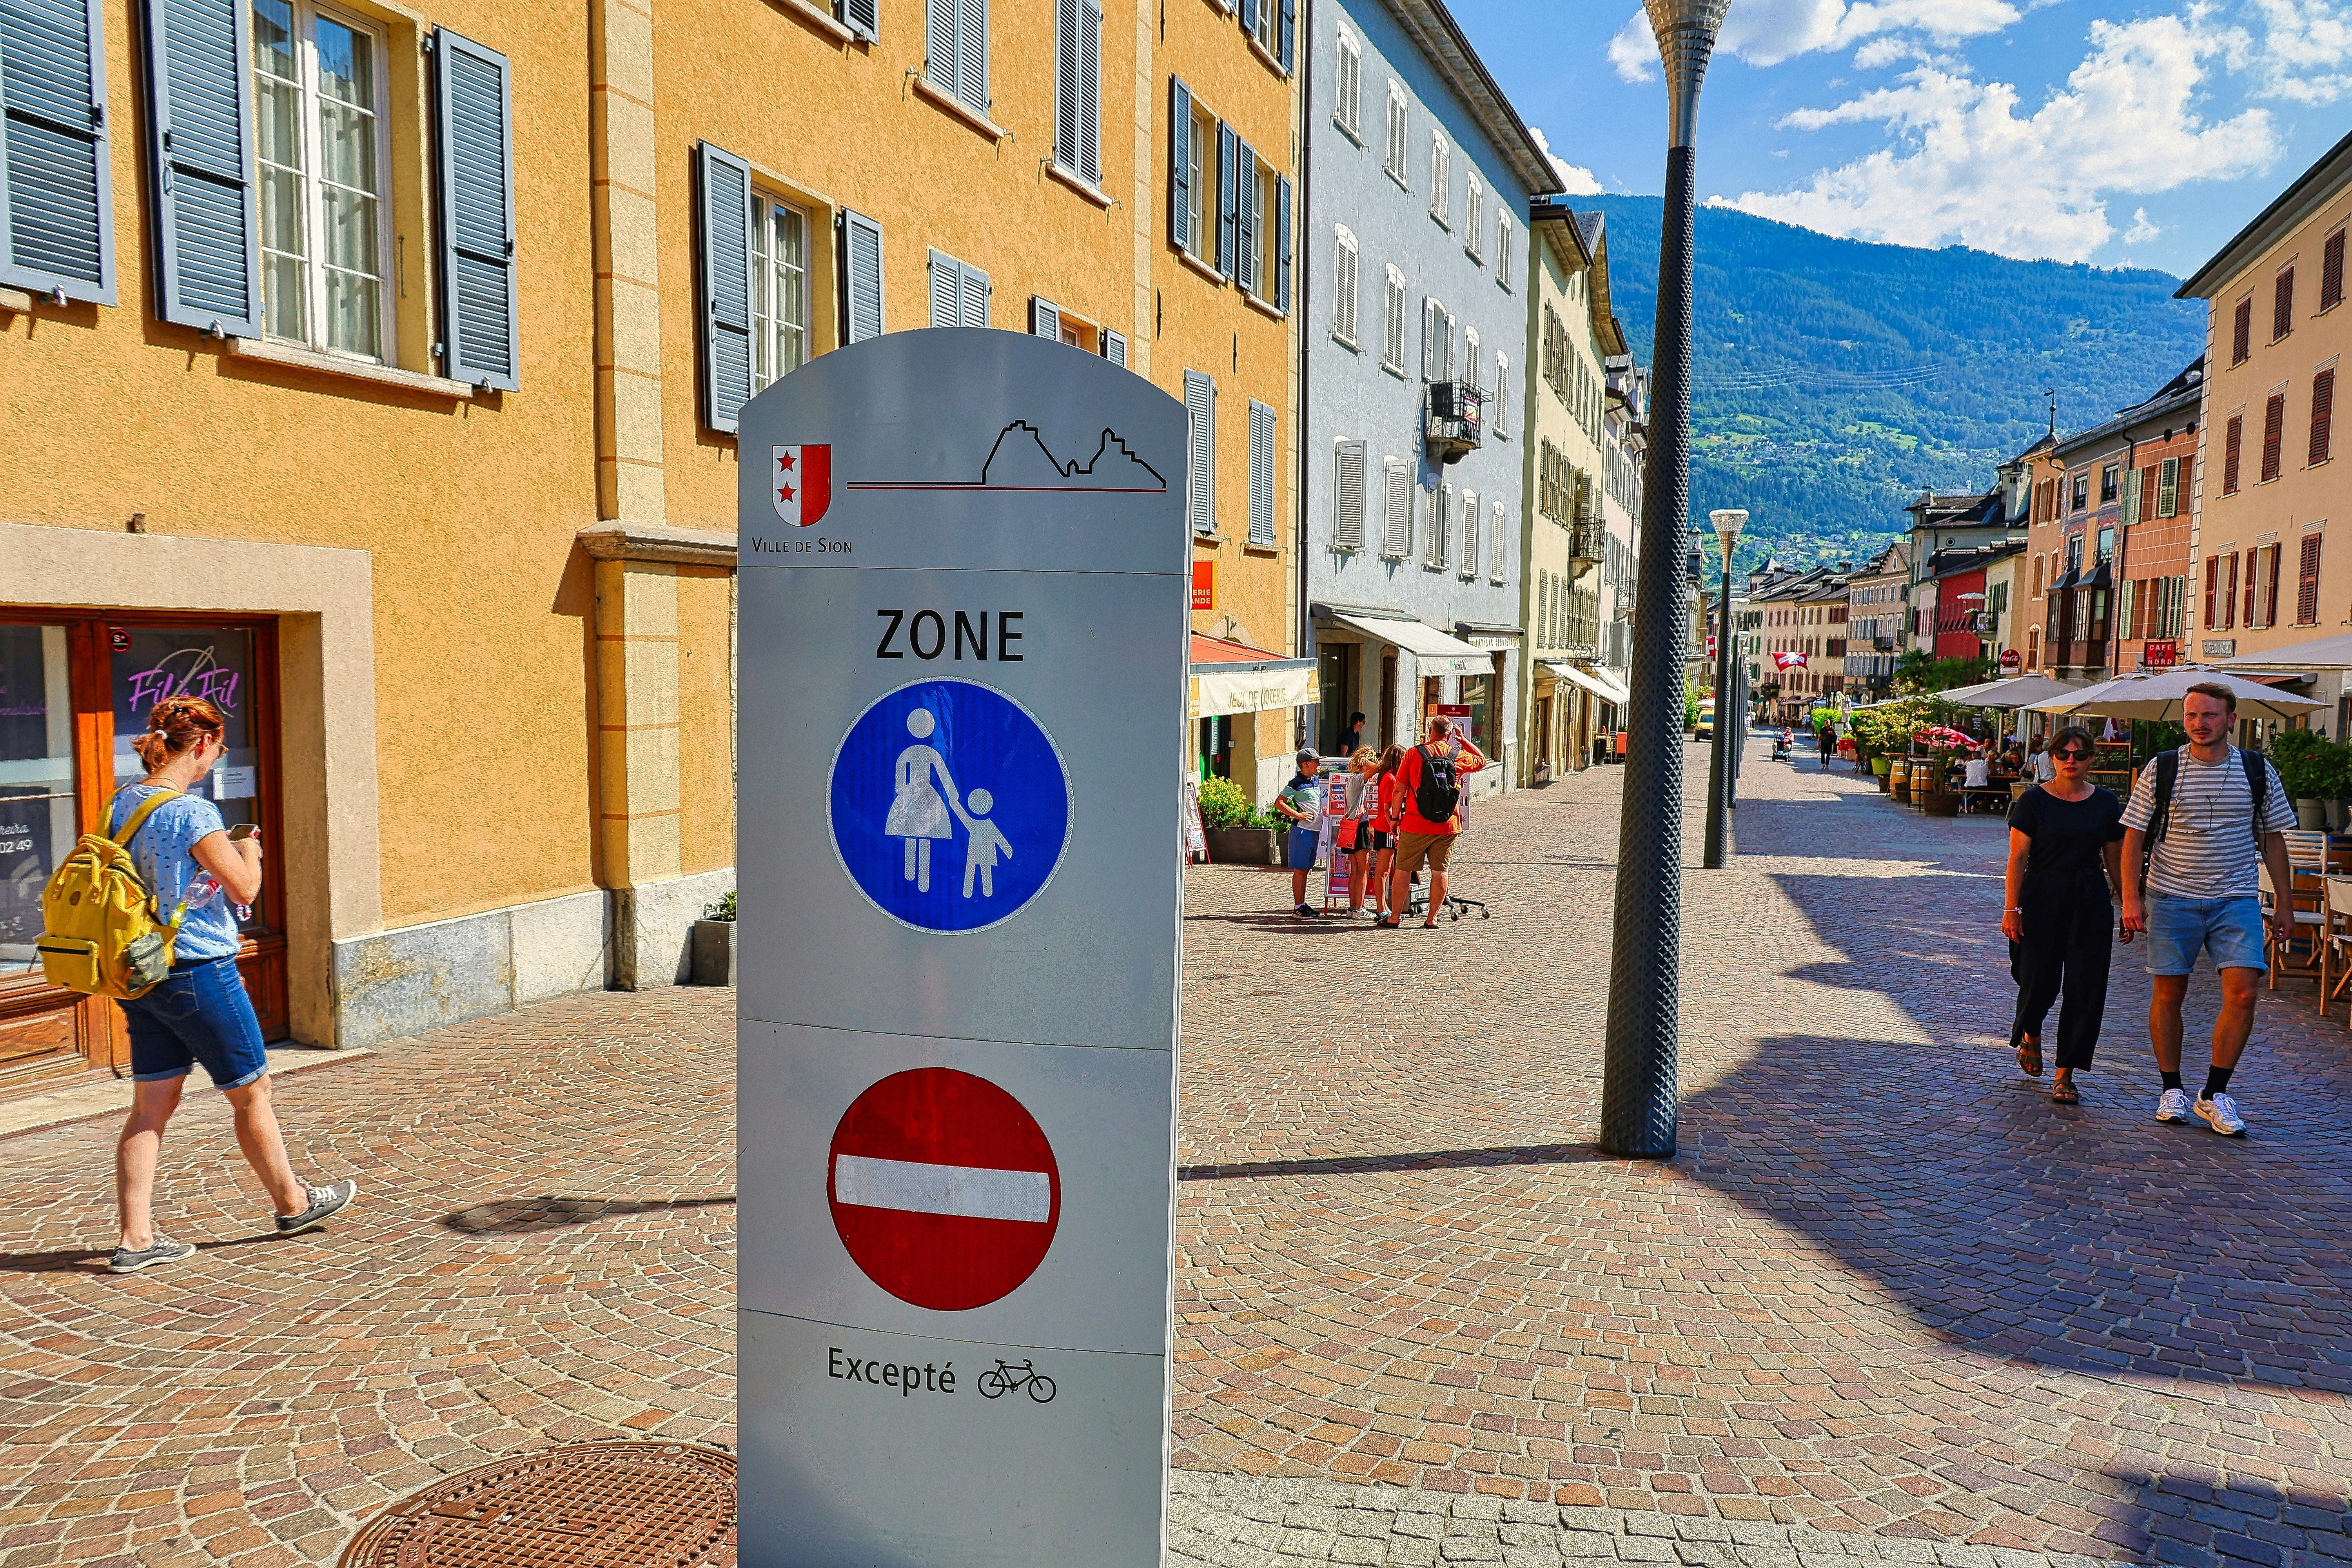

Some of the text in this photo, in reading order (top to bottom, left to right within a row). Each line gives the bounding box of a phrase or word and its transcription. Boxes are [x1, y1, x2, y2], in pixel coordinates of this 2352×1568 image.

[876, 609, 1024, 662] ZONE
[197, 668, 239, 708] Fil
[1228, 687, 1287, 708] JEUX DE LOTERIE
[16, 839, 34, 851] 49
[828, 1346, 956, 1397] Excepté
